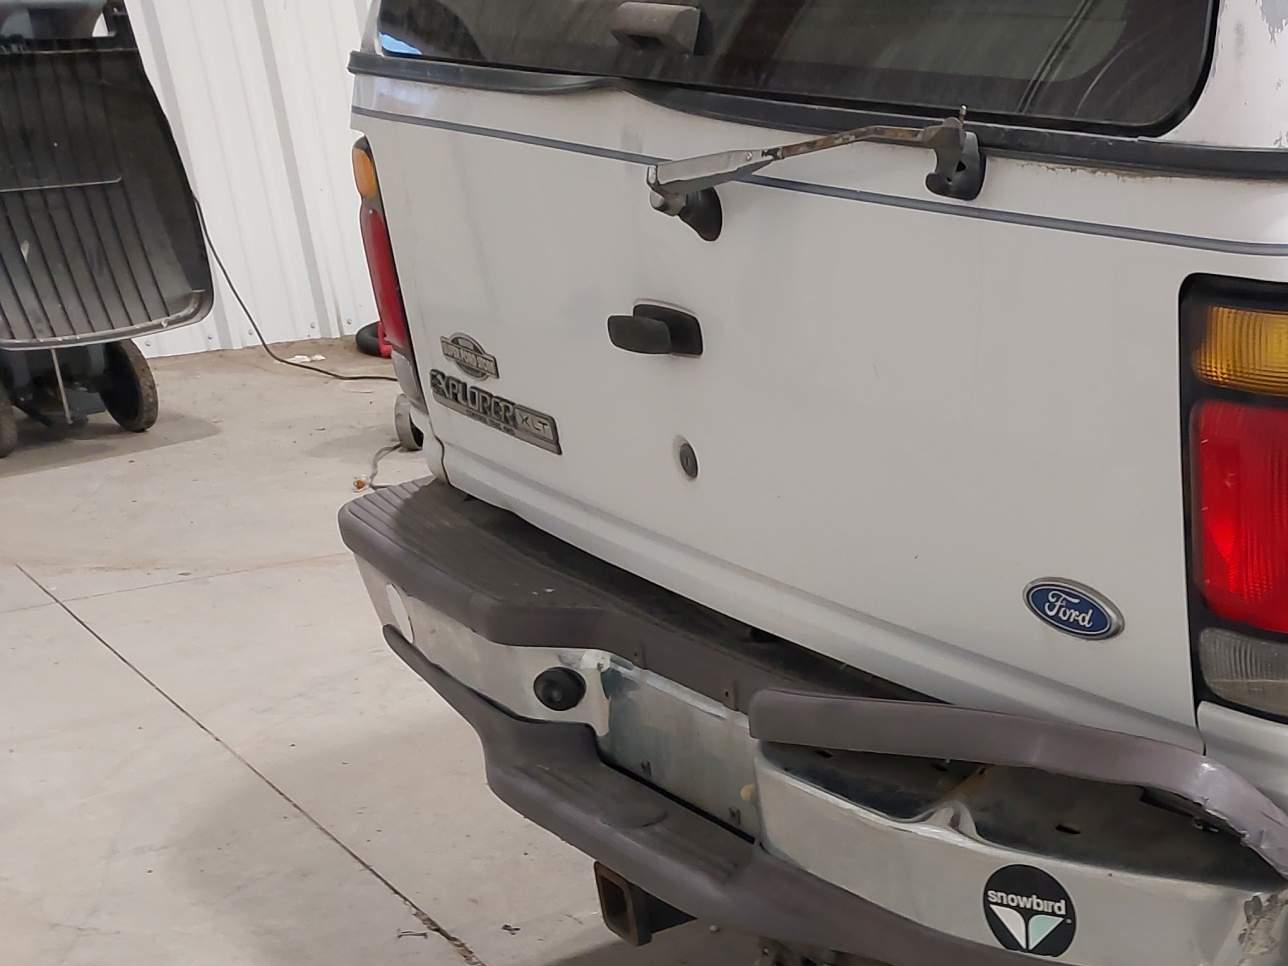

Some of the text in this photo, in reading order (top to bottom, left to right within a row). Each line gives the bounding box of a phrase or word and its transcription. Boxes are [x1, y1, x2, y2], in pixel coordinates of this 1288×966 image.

[520, 412, 549, 434] XLT
[1044, 590, 1093, 628] Ford
[987, 890, 1067, 916] snowbird
